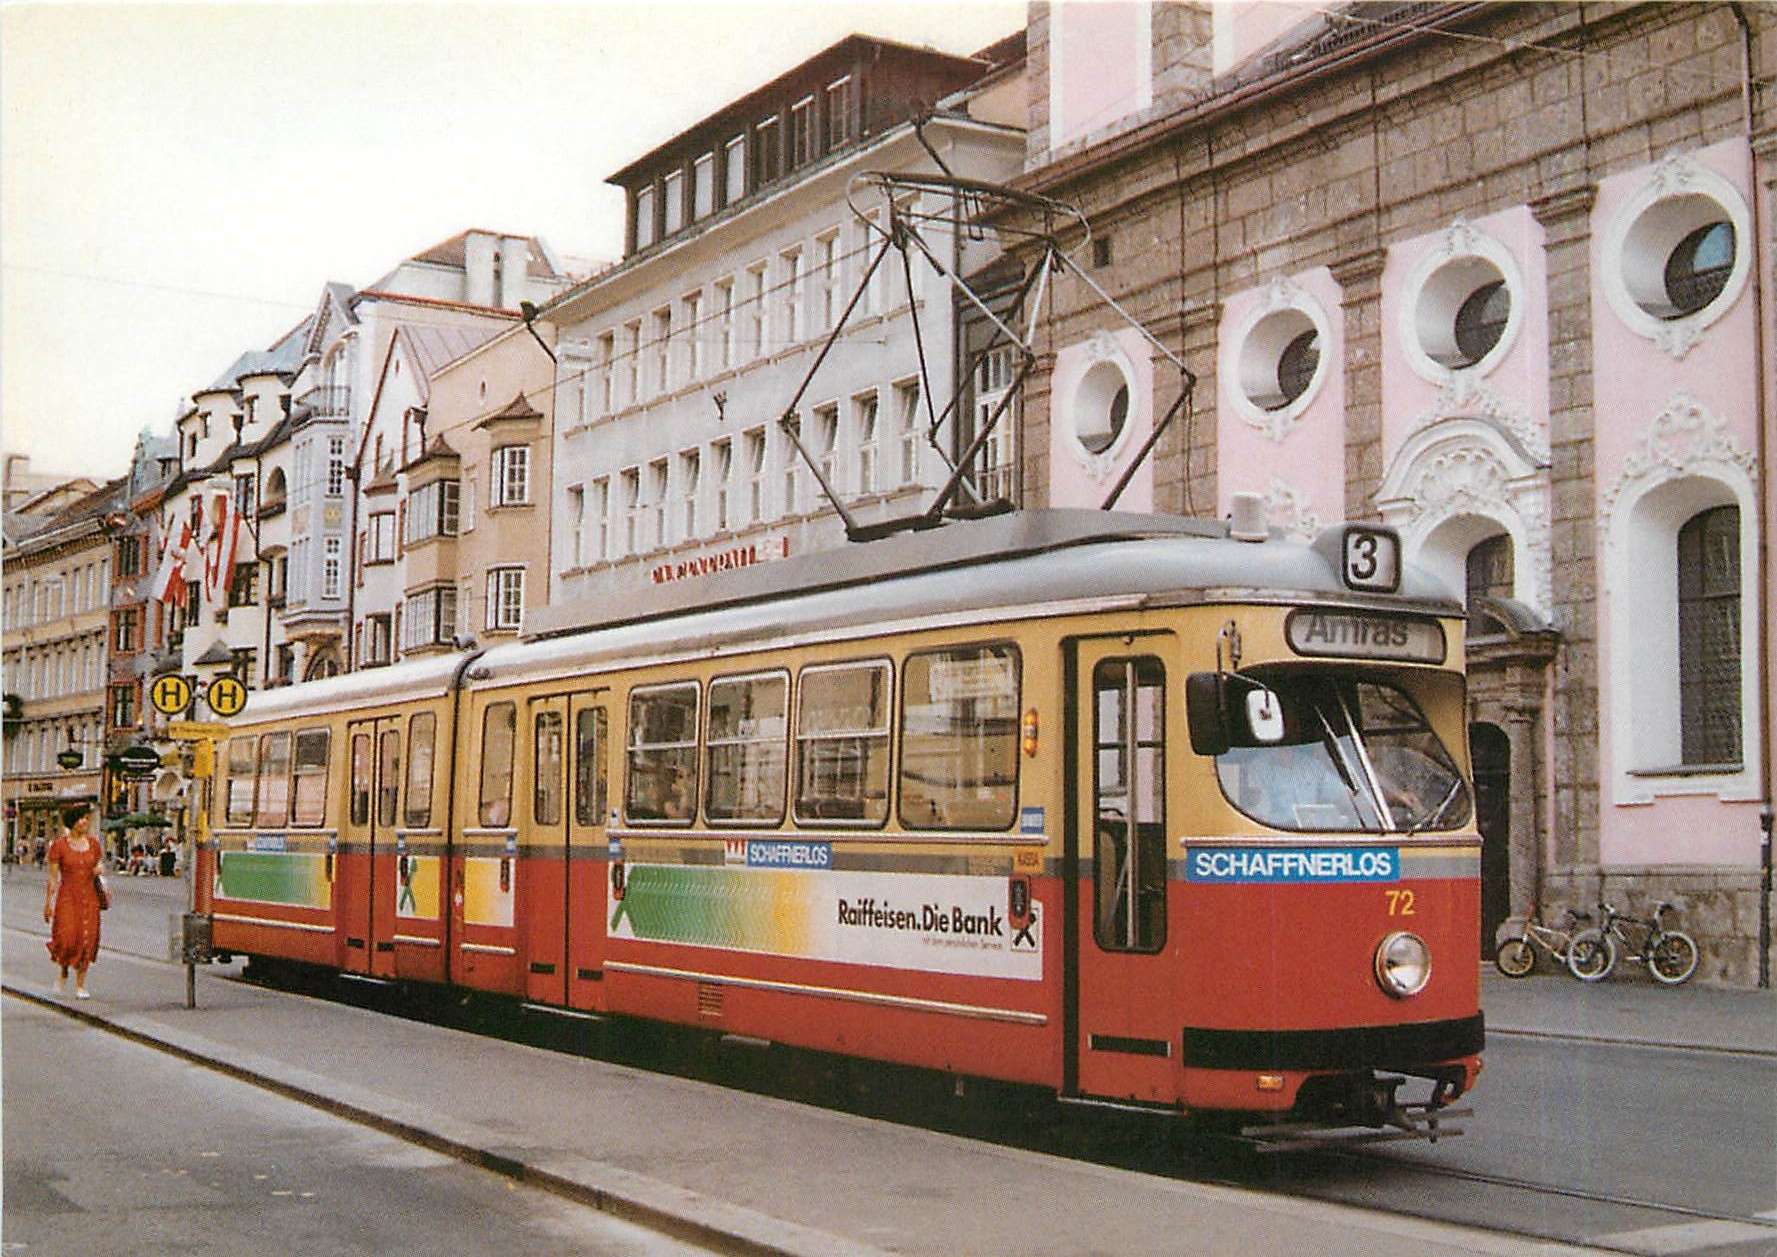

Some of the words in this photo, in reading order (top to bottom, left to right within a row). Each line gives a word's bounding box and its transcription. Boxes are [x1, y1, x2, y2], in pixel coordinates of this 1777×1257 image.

[1351, 534, 1378, 580] 3
[1305, 612, 1408, 647] Amras
[161, 681, 181, 707] H
[217, 683, 237, 709] H
[1195, 852, 1392, 877] SCHAFFNERLOS
[1384, 889, 1415, 916] 72
[951, 905, 1003, 936] Bank
